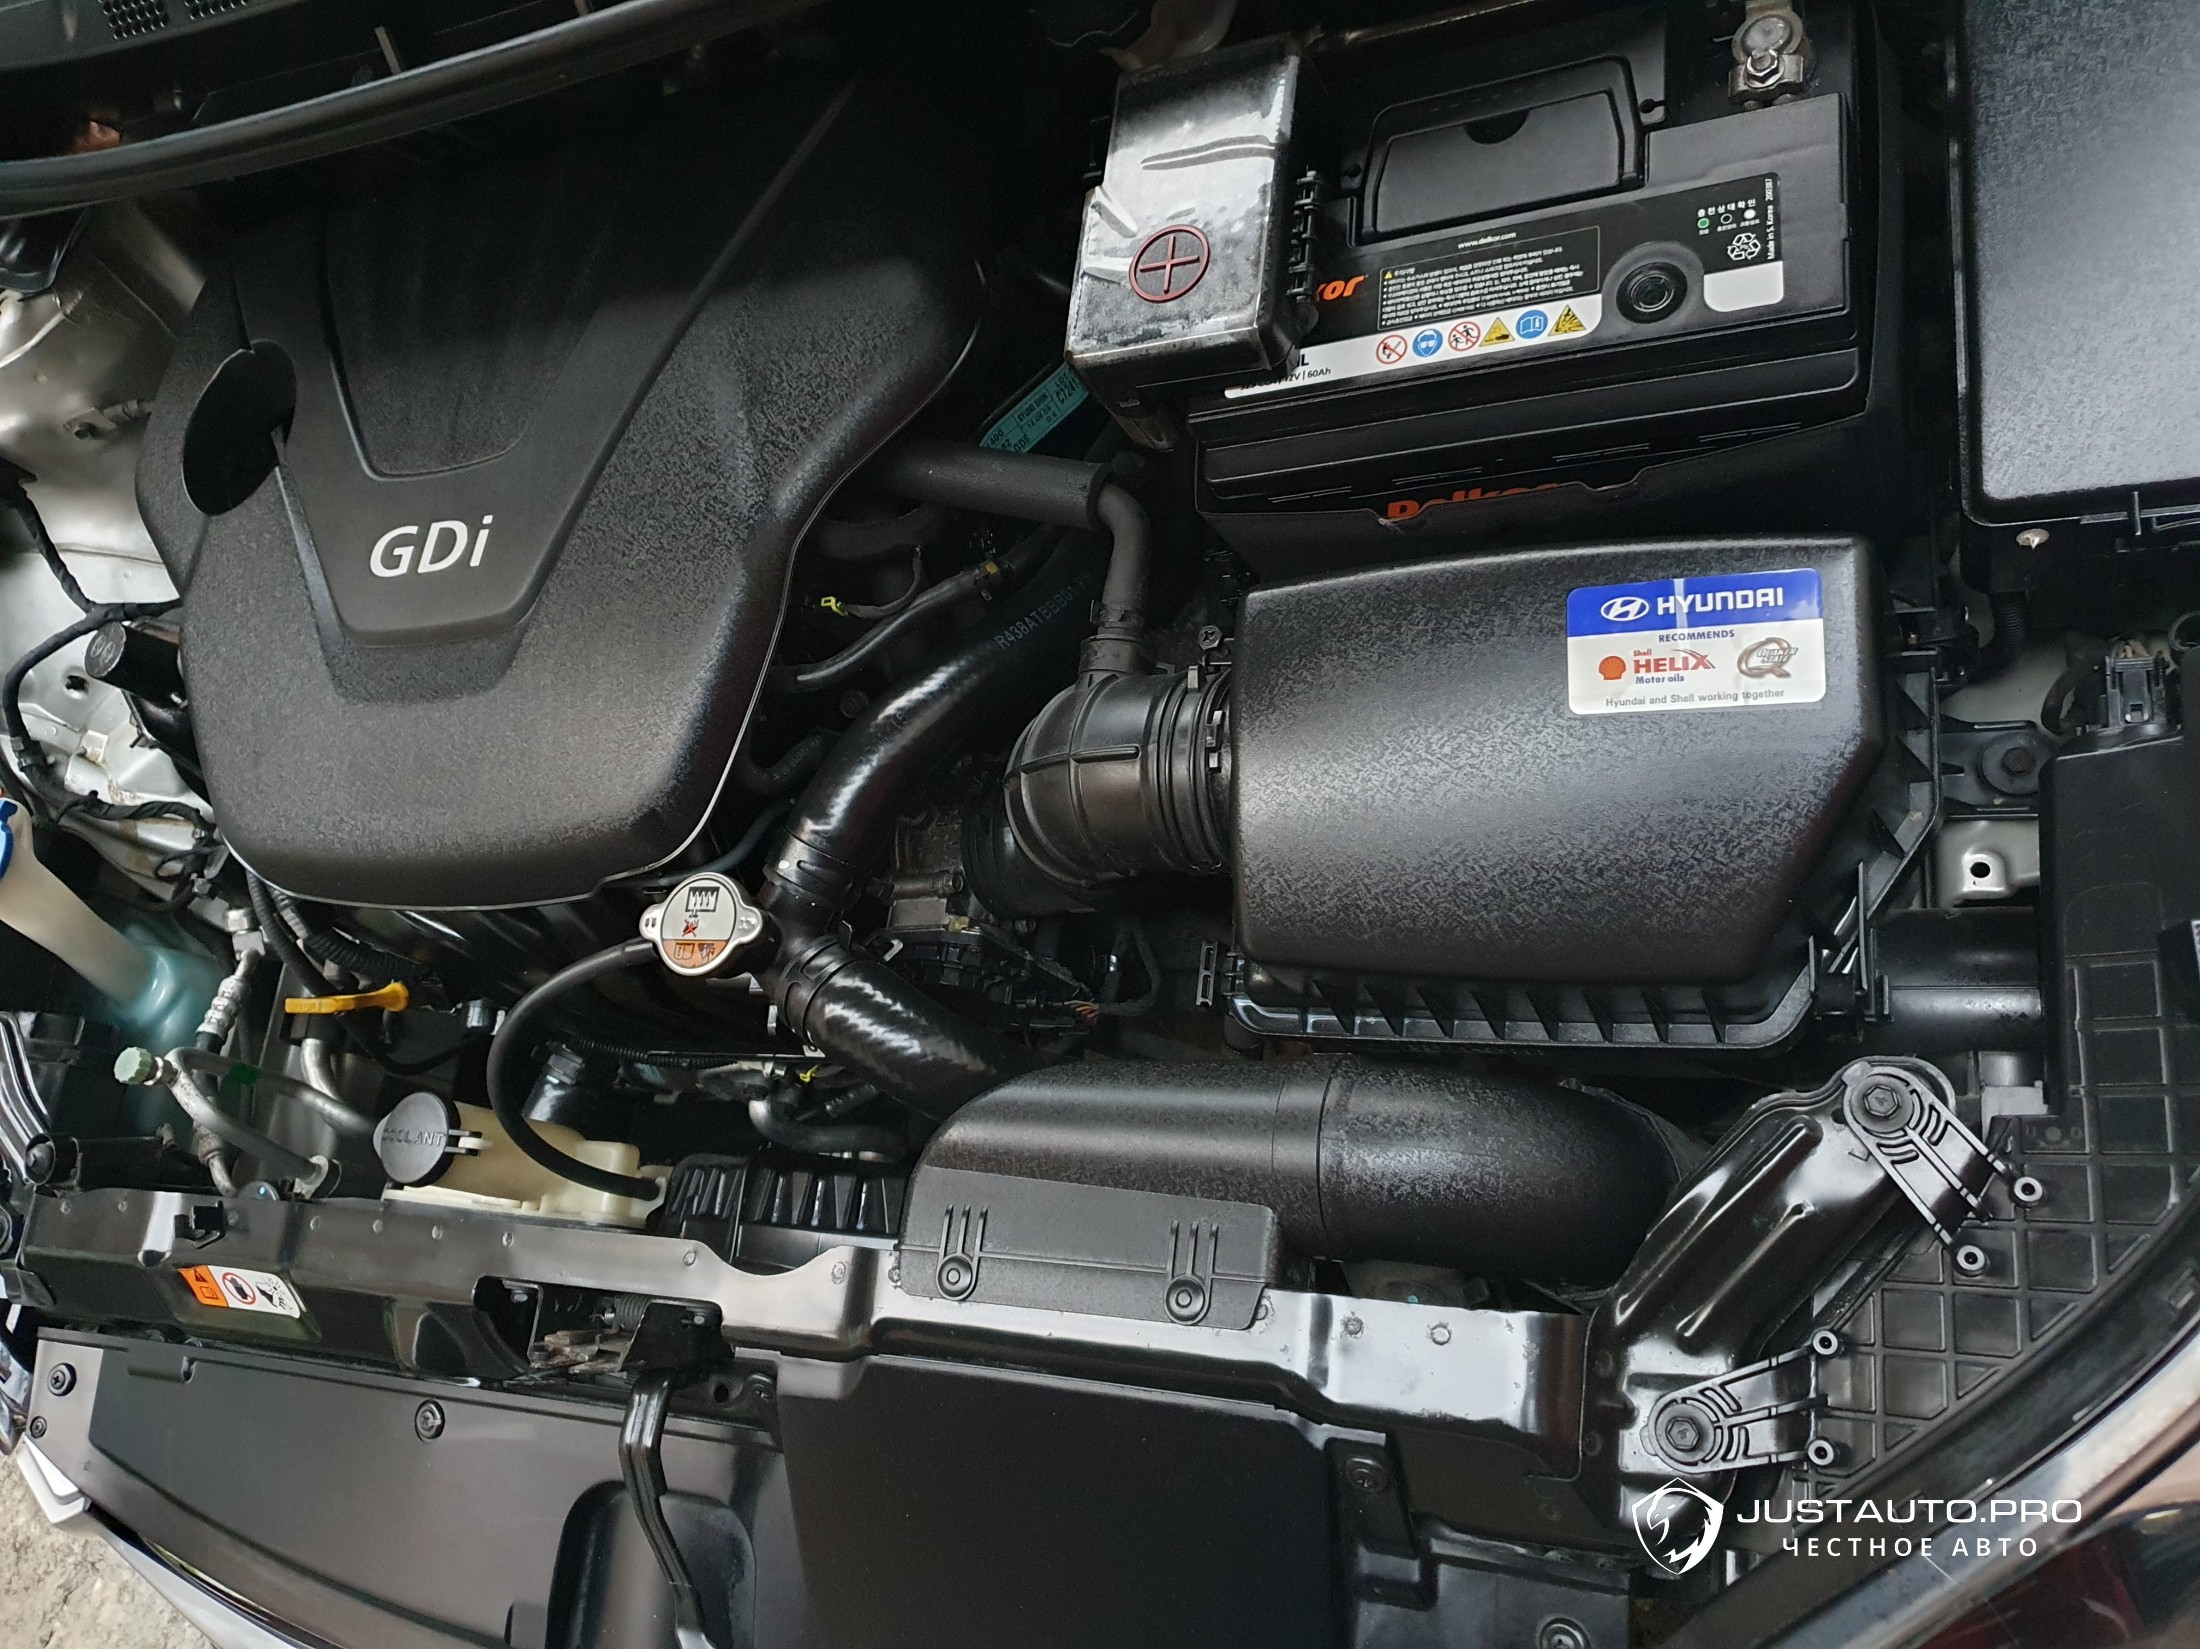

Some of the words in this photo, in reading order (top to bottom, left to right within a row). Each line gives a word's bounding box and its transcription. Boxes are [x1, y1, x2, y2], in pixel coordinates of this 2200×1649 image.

[1765, 205, 1774, 225] Korea
[1307, 367, 1331, 378] 60Ah
[369, 514, 494, 578] GDi
[1657, 586, 1784, 616] HYUNDAI
[1658, 629, 1736, 643] RECOMMENDS
[1632, 648, 1652, 658] Shell
[1756, 647, 1798, 660] QUAKER
[1761, 655, 1790, 664] STATE
[1633, 654, 1713, 674] HELIX
[1635, 674, 1665, 685] Motor
[1667, 674, 1685, 684] oils
[1605, 696, 1646, 709] Hyundai
[1649, 694, 1667, 705] and
[1670, 693, 1695, 704] Shell
[1698, 691, 1739, 704] working
[1742, 689, 1784, 703] together
